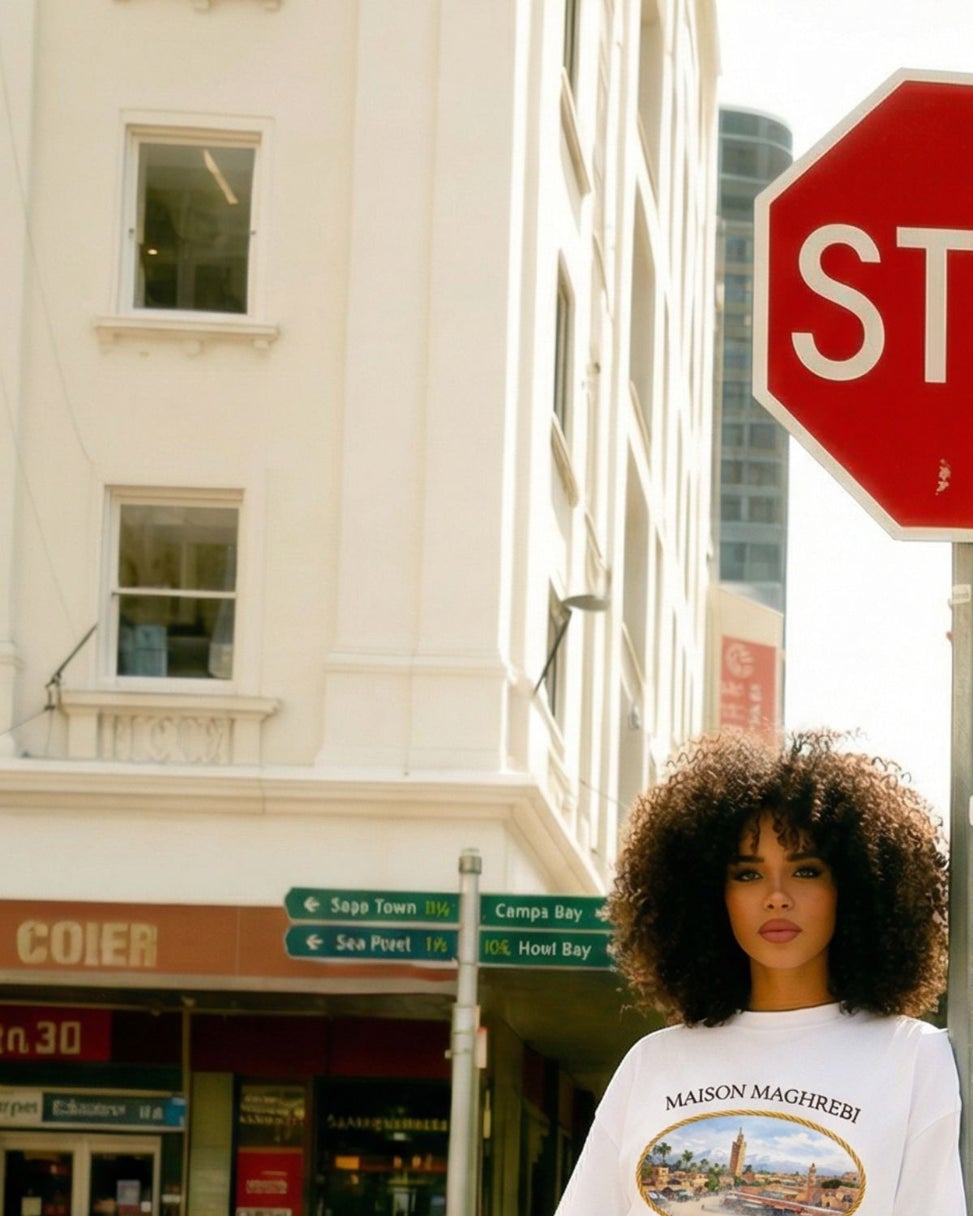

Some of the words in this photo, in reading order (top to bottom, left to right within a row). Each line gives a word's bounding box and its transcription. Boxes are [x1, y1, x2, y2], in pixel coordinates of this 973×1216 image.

[374, 898, 417, 915] Town
[554, 904, 583, 923] Bay
[336, 934, 367, 951] Sea
[562, 941, 592, 961] Bay
[35, 1020, 82, 1055] 30
[665, 1084, 748, 1111] MAISON
[750, 1084, 862, 1124] MAGHREBI
